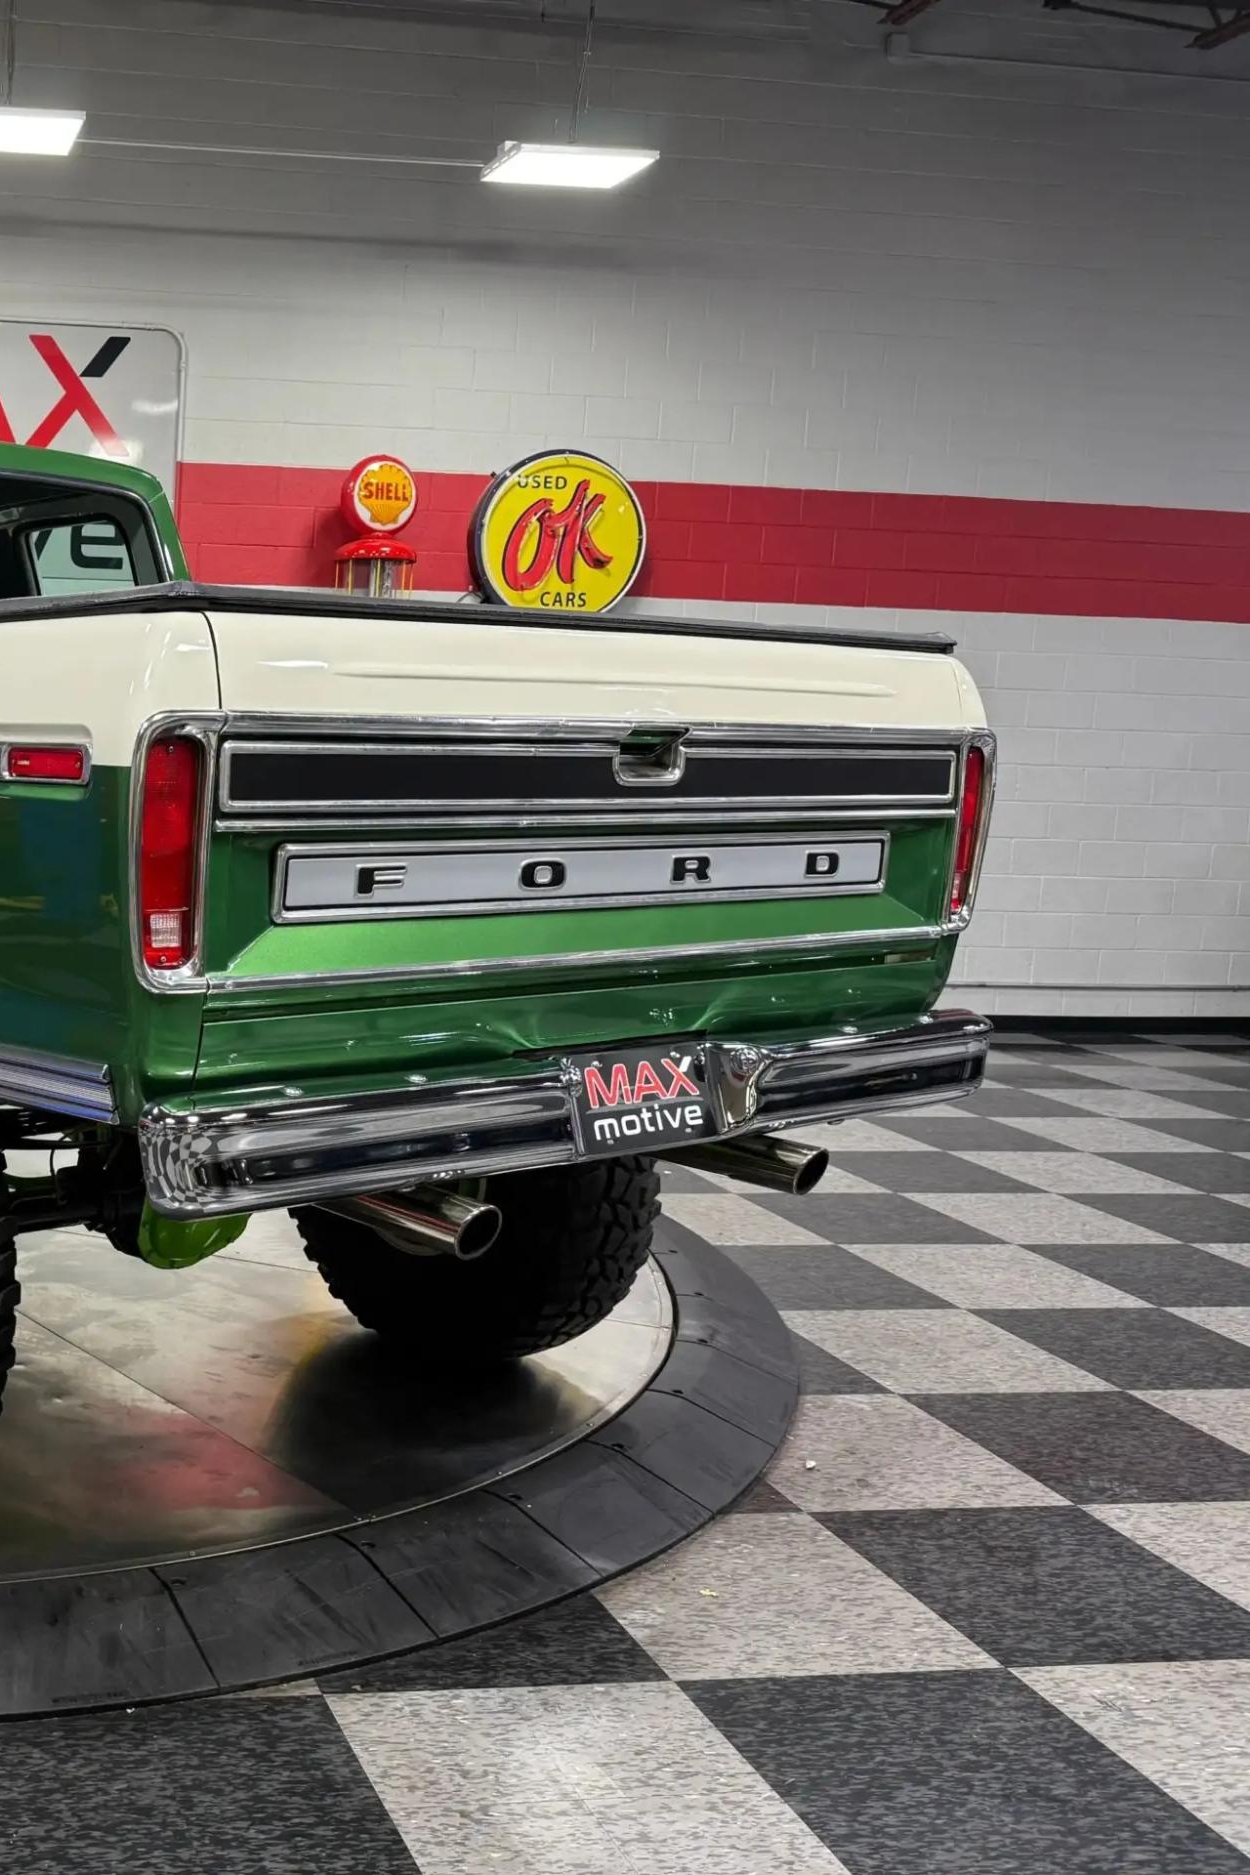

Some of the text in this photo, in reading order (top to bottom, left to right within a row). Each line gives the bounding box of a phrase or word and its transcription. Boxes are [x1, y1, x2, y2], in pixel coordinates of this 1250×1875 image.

[362, 481, 410, 502] SHELL
[517, 474, 568, 490] USED
[539, 591, 587, 608] CARS
[354, 850, 840, 898] FORD
[584, 1055, 701, 1110] MAX
[593, 1103, 704, 1142] motive
